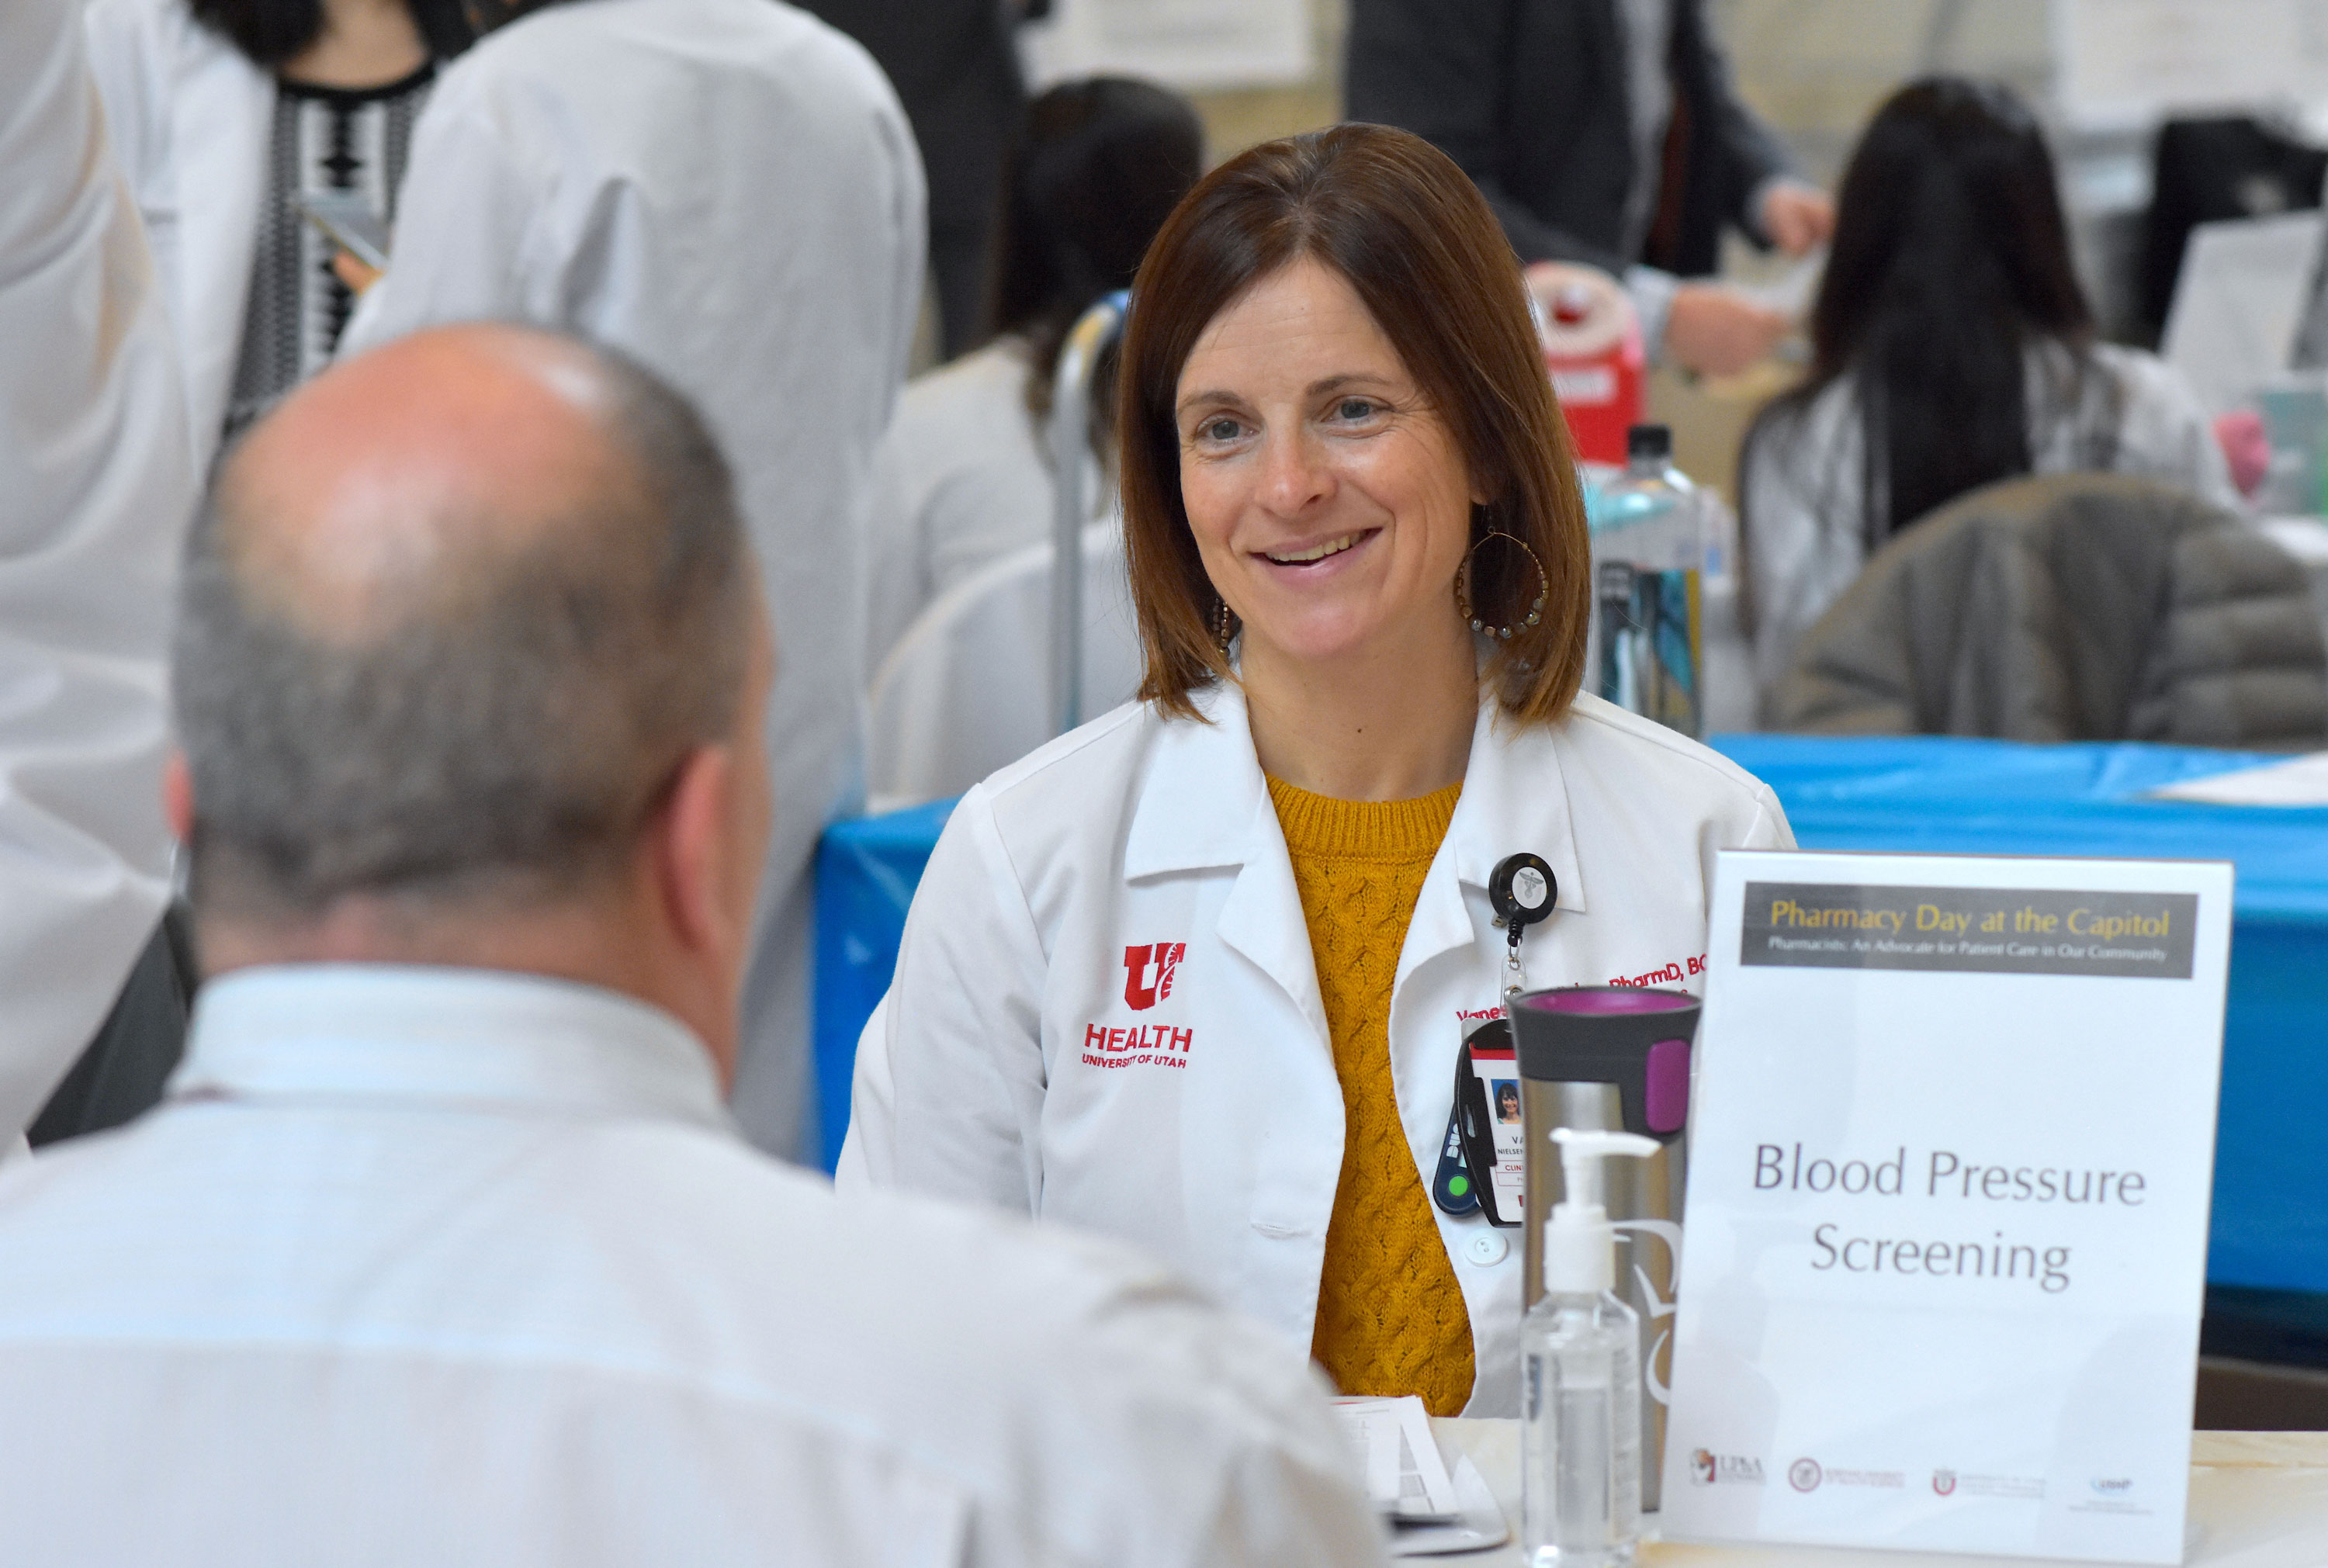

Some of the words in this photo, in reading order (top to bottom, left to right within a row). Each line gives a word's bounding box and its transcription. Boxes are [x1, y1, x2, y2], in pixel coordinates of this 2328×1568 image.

[1771, 899, 1907, 936] Pharmacy
[1916, 904, 1972, 937] Day
[1981, 911, 2005, 933] at
[2014, 905, 2058, 933] the
[2067, 908, 2170, 941] Capitol
[1853, 937, 1871, 952] An
[1874, 938, 1935, 954] Advocate
[1937, 940, 1956, 954] for
[1959, 940, 2004, 956] Patient
[2007, 942, 2039, 957] Care
[2041, 943, 2055, 957] in
[2057, 943, 2085, 958] Our
[2087, 944, 2167, 964] Community
[1084, 1023, 1193, 1052] HEALTH
[1082, 1053, 1137, 1068] UNIVERSITY
[1138, 1054, 1152, 1064] OF
[1154, 1055, 1187, 1069] UTAH
[1754, 1142, 1907, 1196] Blood
[1927, 1151, 2146, 1206] Pressure
[1810, 1223, 2073, 1293] Screening
